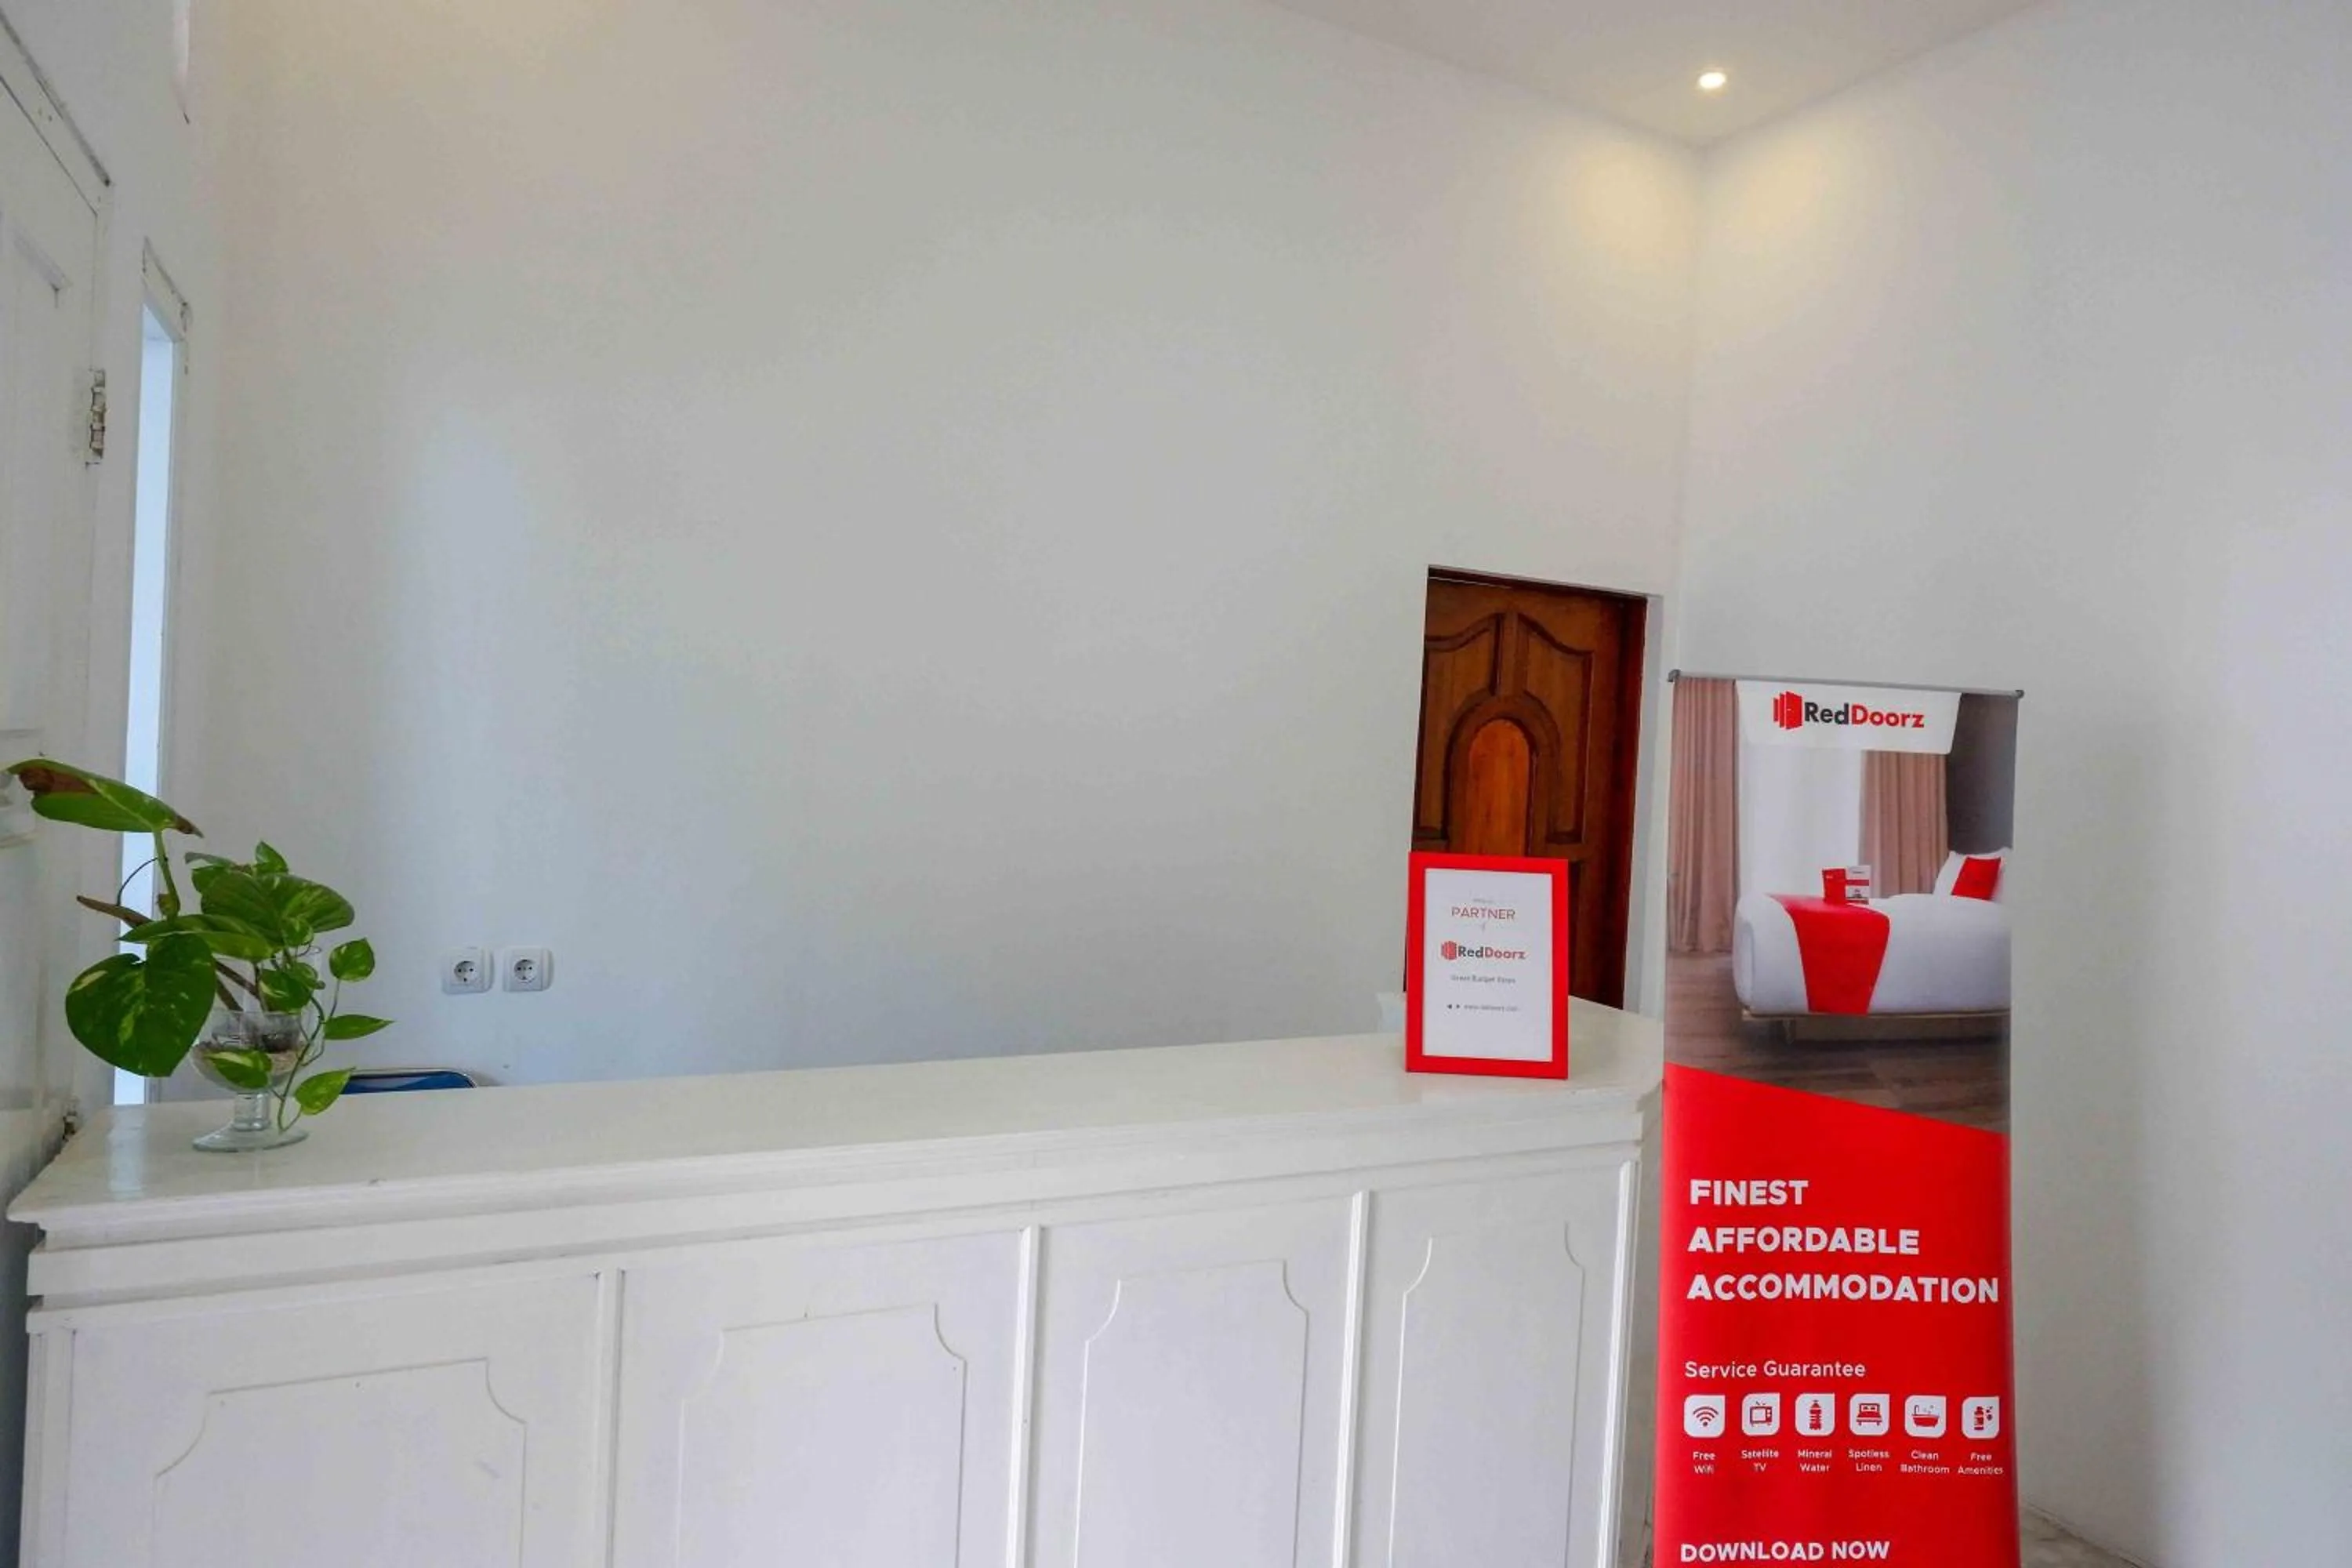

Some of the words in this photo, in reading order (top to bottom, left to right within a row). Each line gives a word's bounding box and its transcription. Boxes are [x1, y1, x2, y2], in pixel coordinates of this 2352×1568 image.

[1804, 702, 1926, 728] RedDoorz
[1451, 906, 1515, 920] PARTNER
[1458, 945, 1526, 960] RedDoorz
[1690, 1178, 1809, 1206] FINEST
[1687, 1226, 1921, 1255] AFFORDABLE
[1686, 1273, 2000, 1304] ACCOMMODATION
[1685, 1360, 1757, 1378] Service
[1764, 1360, 1867, 1377] Guarantee
[1693, 1451, 1716, 1461] Free
[1740, 1449, 1780, 1459] Satellite
[1798, 1449, 1833, 1459] Mineral
[1848, 1449, 1890, 1460] Spotless
[1911, 1450, 1940, 1461] Clean
[1969, 1452, 1992, 1462] Free
[1753, 1462, 1767, 1472] TV
[1799, 1462, 1830, 1472] Water
[1855, 1462, 1882, 1472] Linen
[1900, 1463, 1951, 1474] Bathroom
[1957, 1465, 2004, 1475] Amenities
[1680, 1542, 1824, 1563] DOWNLOAD
[1831, 1541, 1890, 1559] NOW
